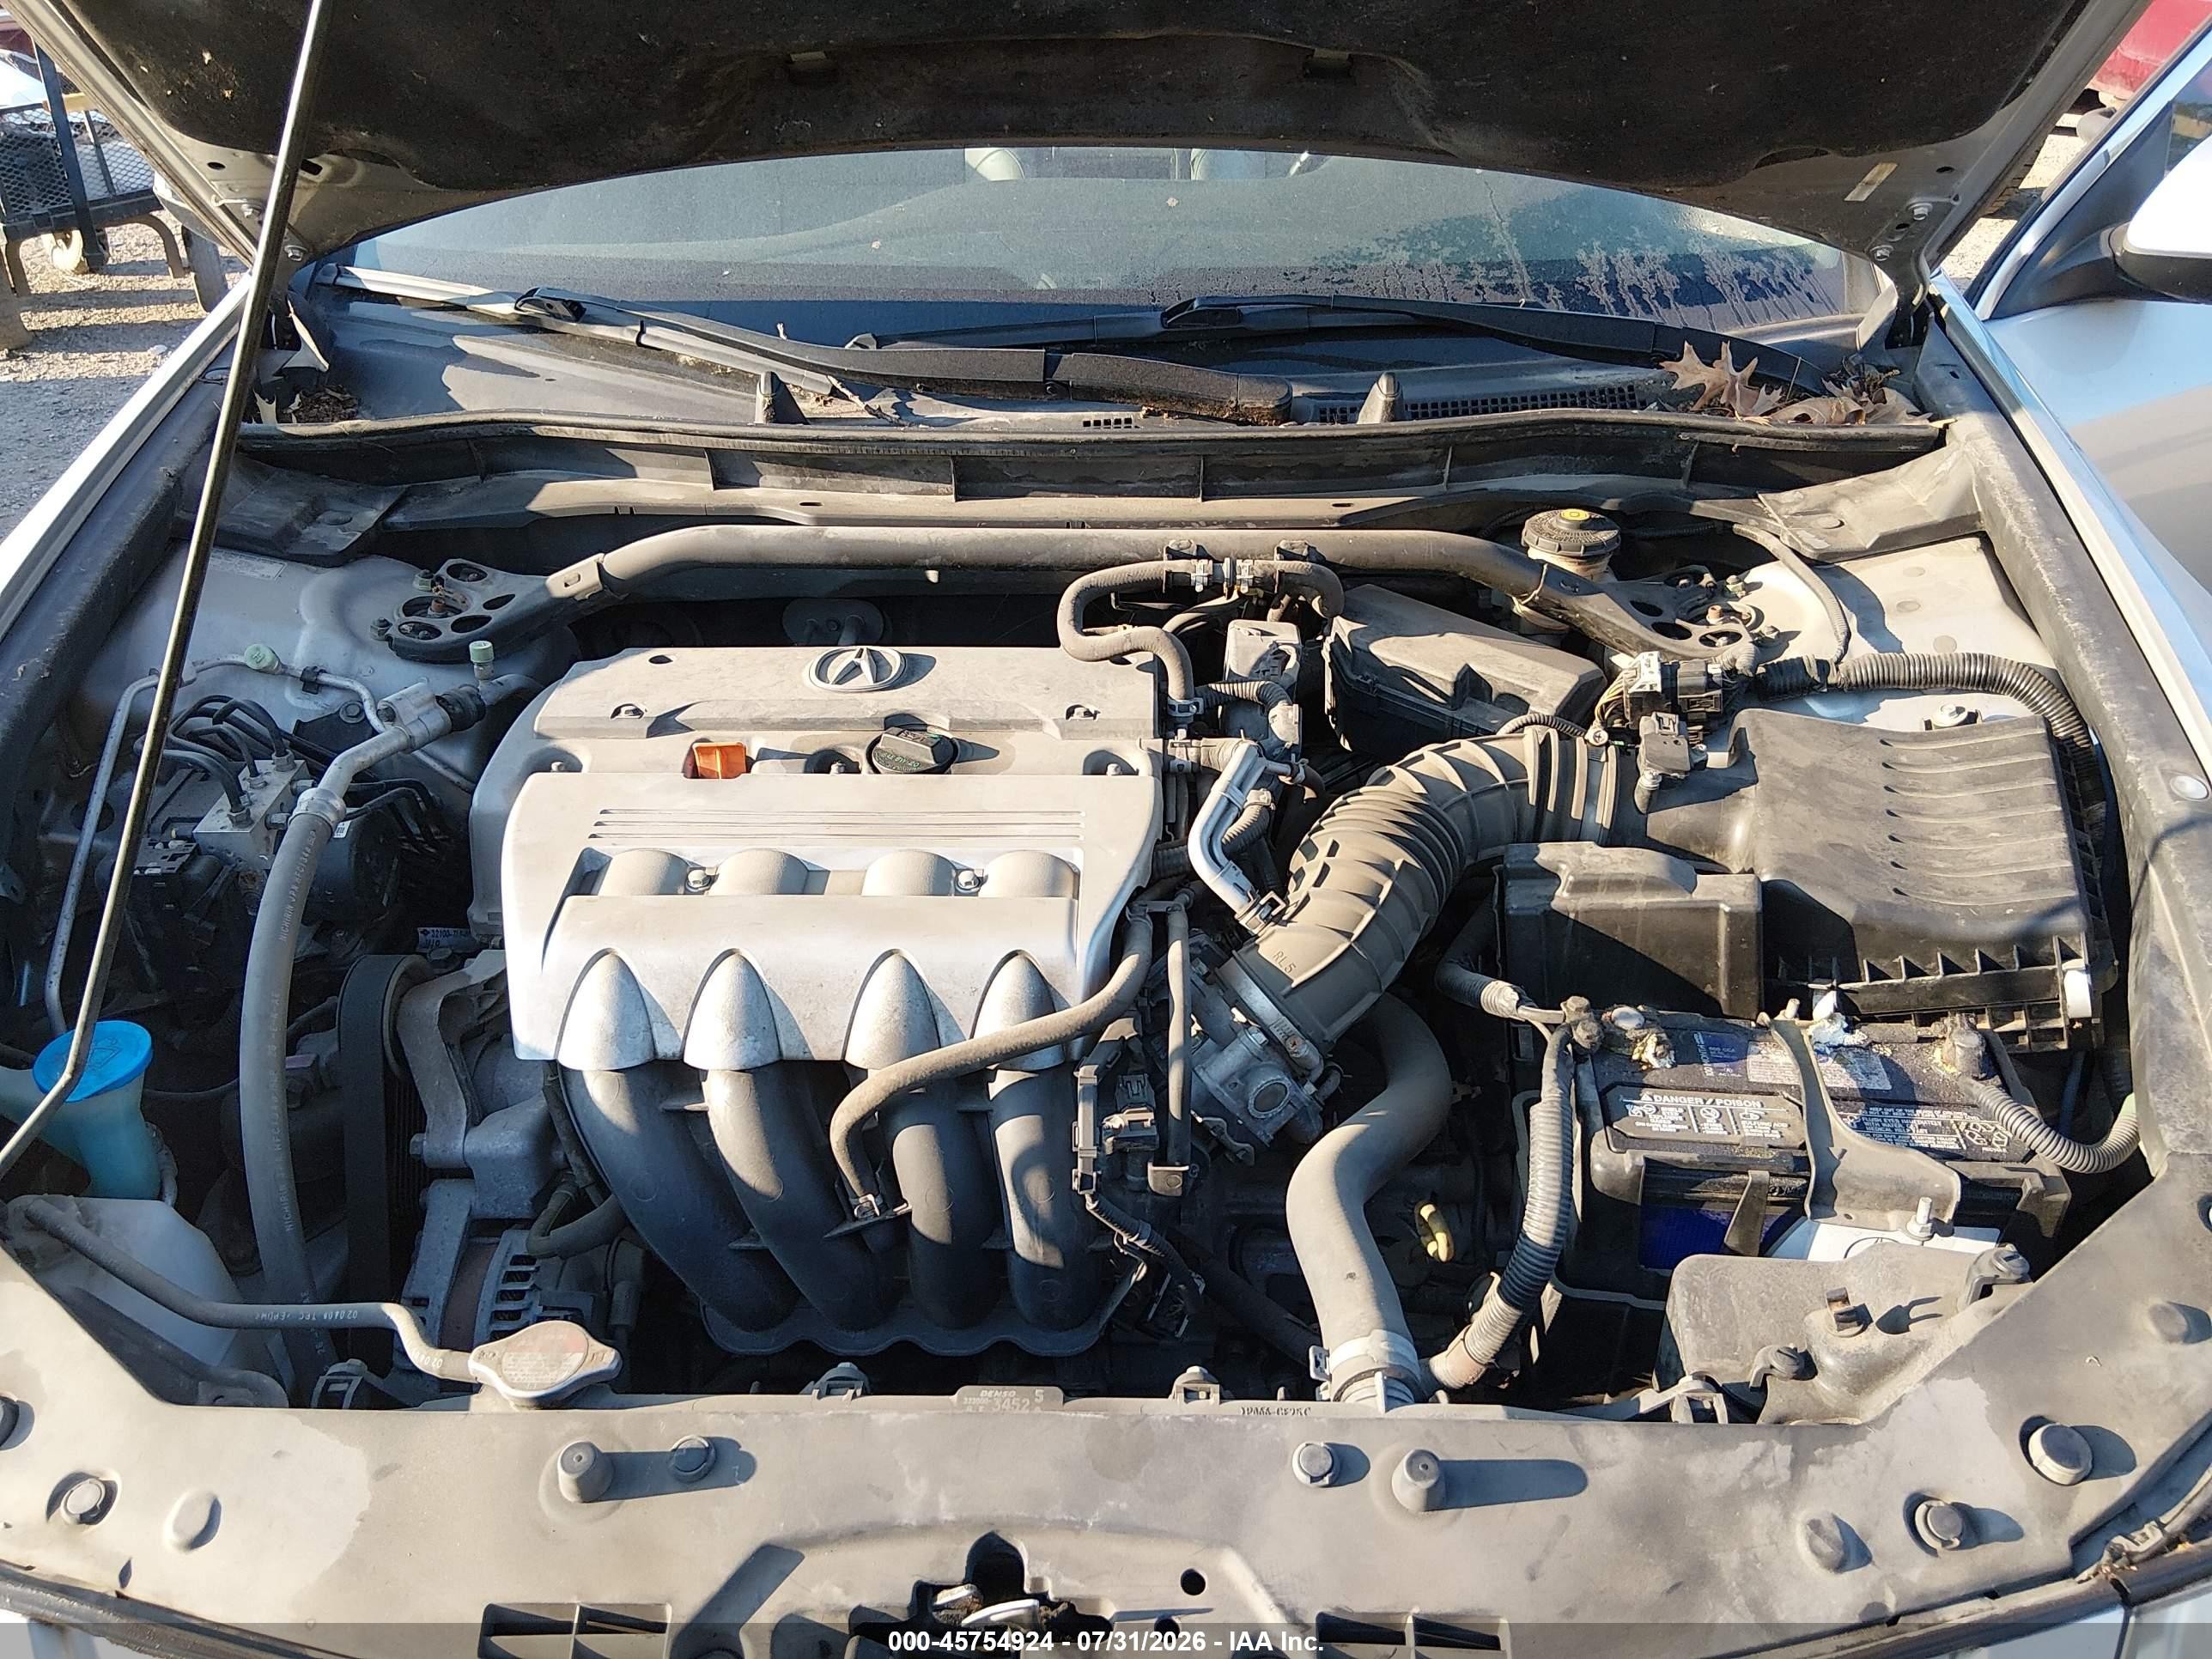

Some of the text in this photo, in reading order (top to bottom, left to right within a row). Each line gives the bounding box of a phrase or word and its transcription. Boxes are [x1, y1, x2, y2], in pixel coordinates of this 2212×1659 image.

[1273, 951, 1297, 974] RL5
[1653, 1094, 1705, 1105] DANGER
[1715, 1098, 1762, 1109] POISON
[979, 1389, 1045, 1403] DENSO 5
